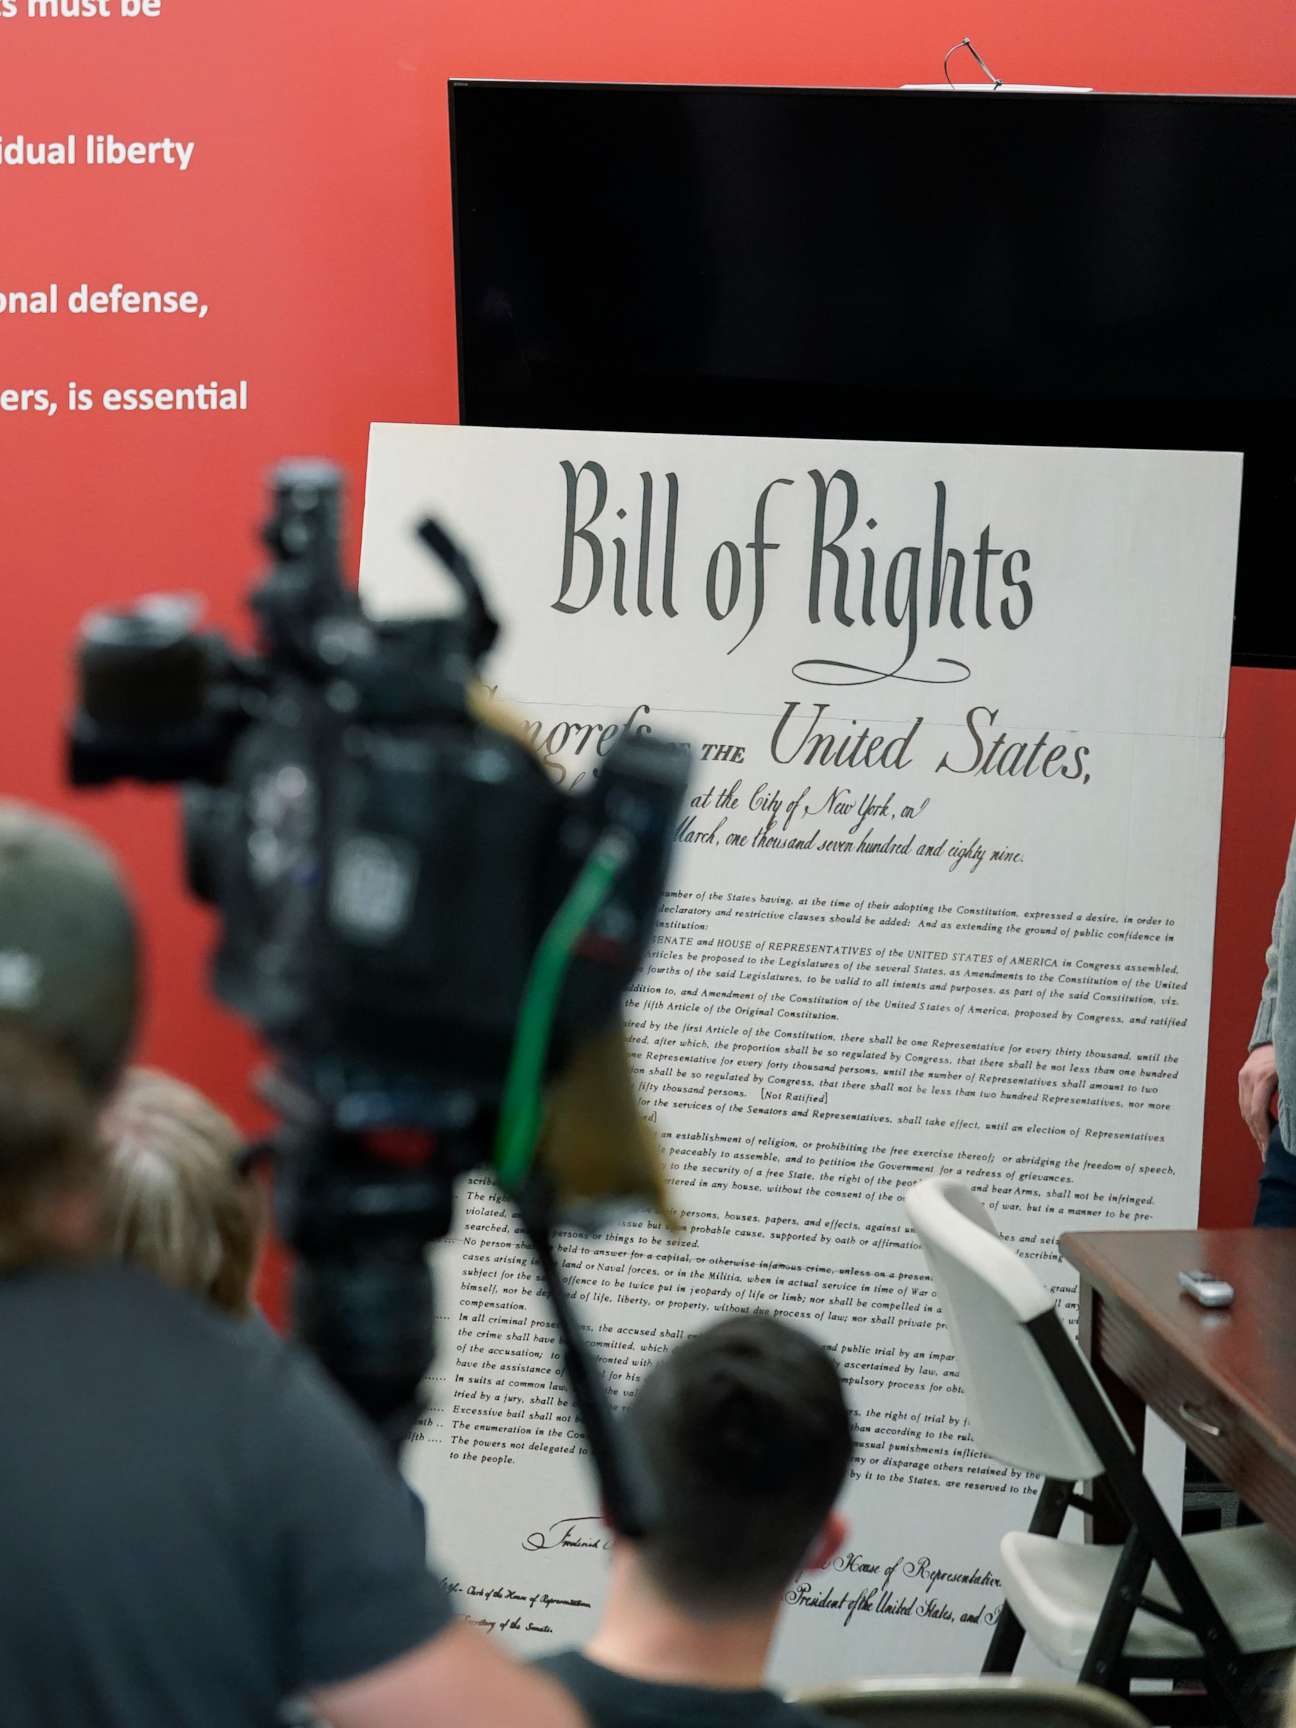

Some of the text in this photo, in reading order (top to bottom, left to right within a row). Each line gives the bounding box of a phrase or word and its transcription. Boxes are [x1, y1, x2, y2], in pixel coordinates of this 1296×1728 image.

[28, 0, 111, 18] must
[121, 0, 161, 17] be
[86, 134, 195, 171] liberty
[68, 283, 208, 318] defense,
[68, 381, 93, 411] is
[102, 380, 247, 411] essential
[550, 459, 1034, 682] Bill of Rights
[700, 701, 1091, 785] THE United States,
[690, 785, 716, 809] at
[715, 778, 743, 809] the
[748, 782, 783, 830] City
[783, 785, 811, 832] of
[802, 786, 855, 819] New
[848, 792, 896, 835] York,
[725, 830, 749, 848] one
[751, 826, 821, 850] thousand
[817, 838, 853, 853] seven
[855, 827, 917, 855] hundred
[915, 838, 949, 857] and
[948, 837, 987, 874] eighty
[989, 846, 1024, 863] nine.
[696, 938, 714, 947] and
[717, 939, 752, 950] HOUSE
[755, 941, 766, 952] of
[768, 942, 872, 957] REPRESENTATIVES
[876, 947, 887, 959] of
[888, 947, 904, 958] the
[908, 949, 949, 961] UNITED
[952, 952, 994, 964] STATES
[996, 955, 1008, 966] of
[1009, 956, 1058, 968] AMERICA
[1062, 959, 1073, 968] in
[1076, 959, 1121, 972] Congress
[1124, 964, 1178, 975] assembled,
[760, 1087, 828, 1104] [Not Ratified]
[674, 1131, 742, 1143] establishment
[744, 1135, 755, 1146] of
[756, 1136, 797, 1148] religion,
[814, 1140, 868, 1154] prohibiting
[870, 1143, 886, 1154] the
[888, 1145, 909, 1157] free
[912, 1149, 953, 1158] exercise
[956, 1150, 995, 1163] thereof;
[1014, 1154, 1061, 1168] abridging
[1064, 1157, 1079, 1168] the
[1082, 1159, 1121, 1170] freedom
[1124, 1162, 1136, 1174] of
[1138, 1165, 1174, 1175] speech,
[459, 1299, 527, 1312] compensation.
[449, 1451, 515, 1465] to the people.
[833, 1552, 881, 1573] House
[882, 1556, 904, 1592] of
[785, 1582, 986, 1627] President of the United States, and
